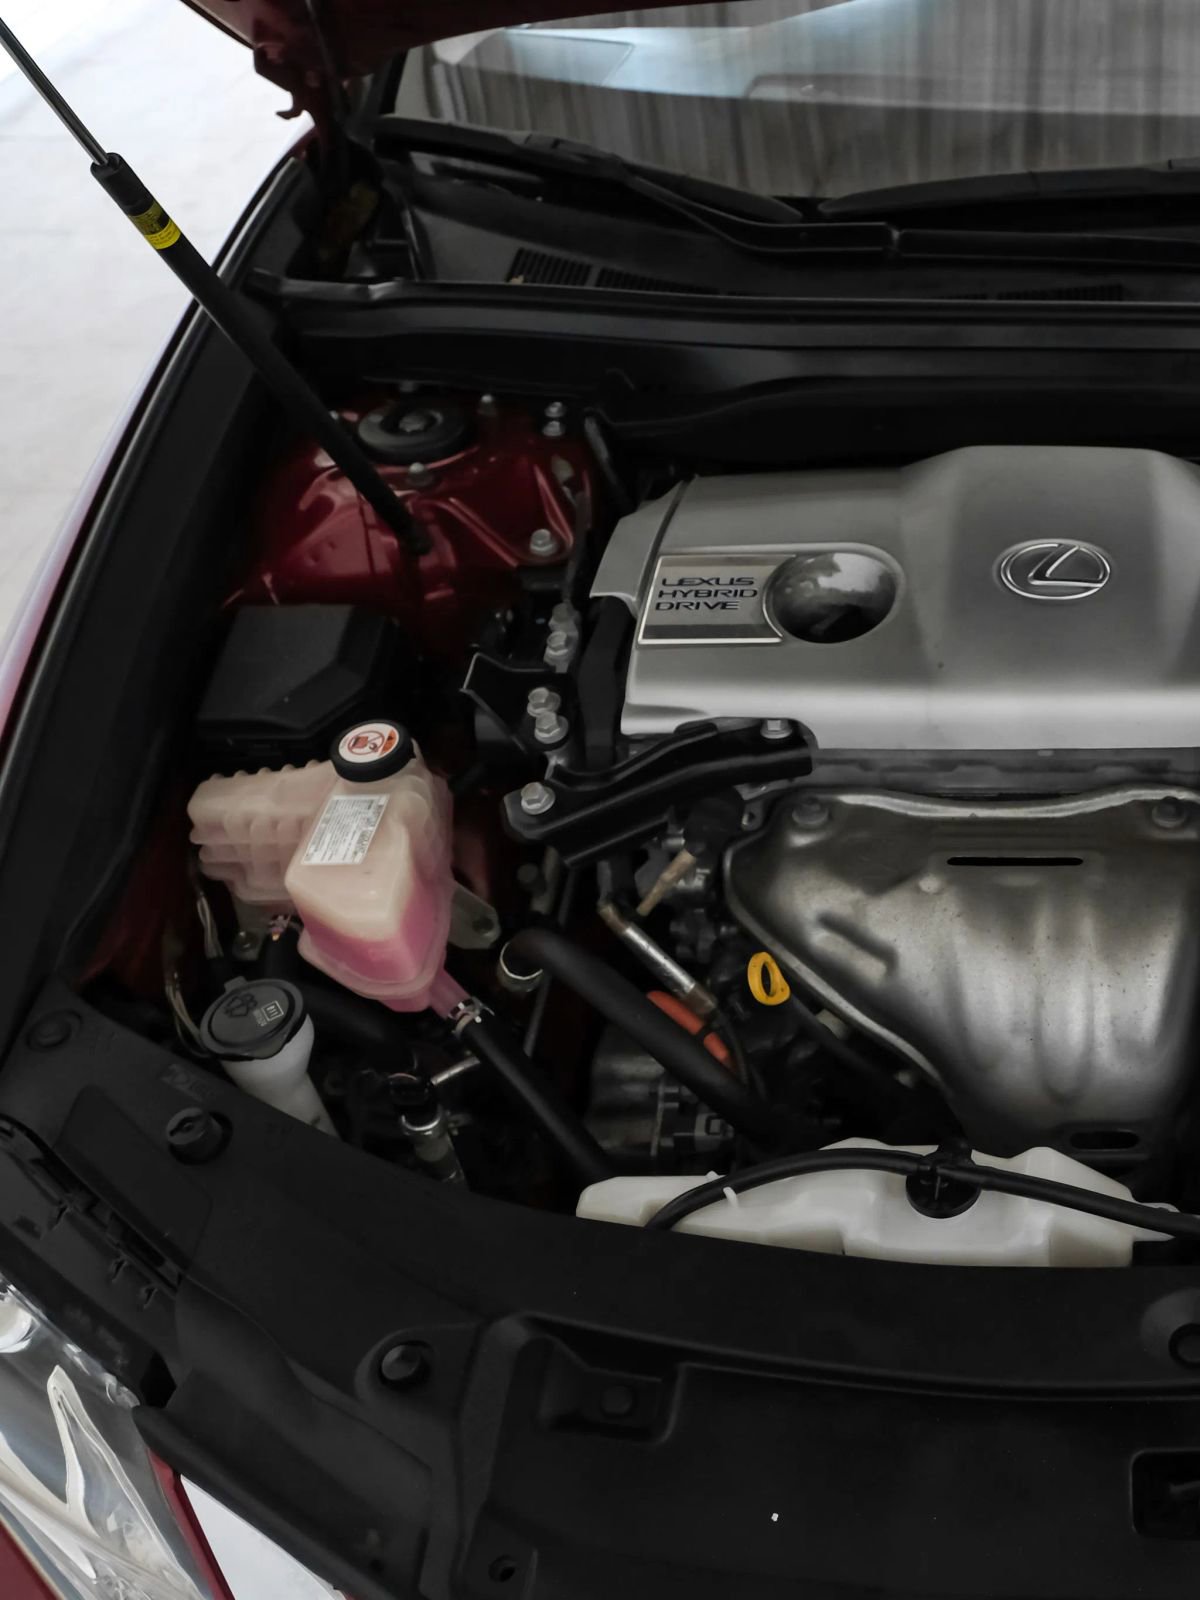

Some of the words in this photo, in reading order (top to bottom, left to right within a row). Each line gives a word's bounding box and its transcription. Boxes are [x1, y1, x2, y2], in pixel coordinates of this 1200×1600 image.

[662, 577, 755, 586] LEXUS
[658, 588, 758, 598] HYBRID
[655, 601, 742, 611] DRIVE
